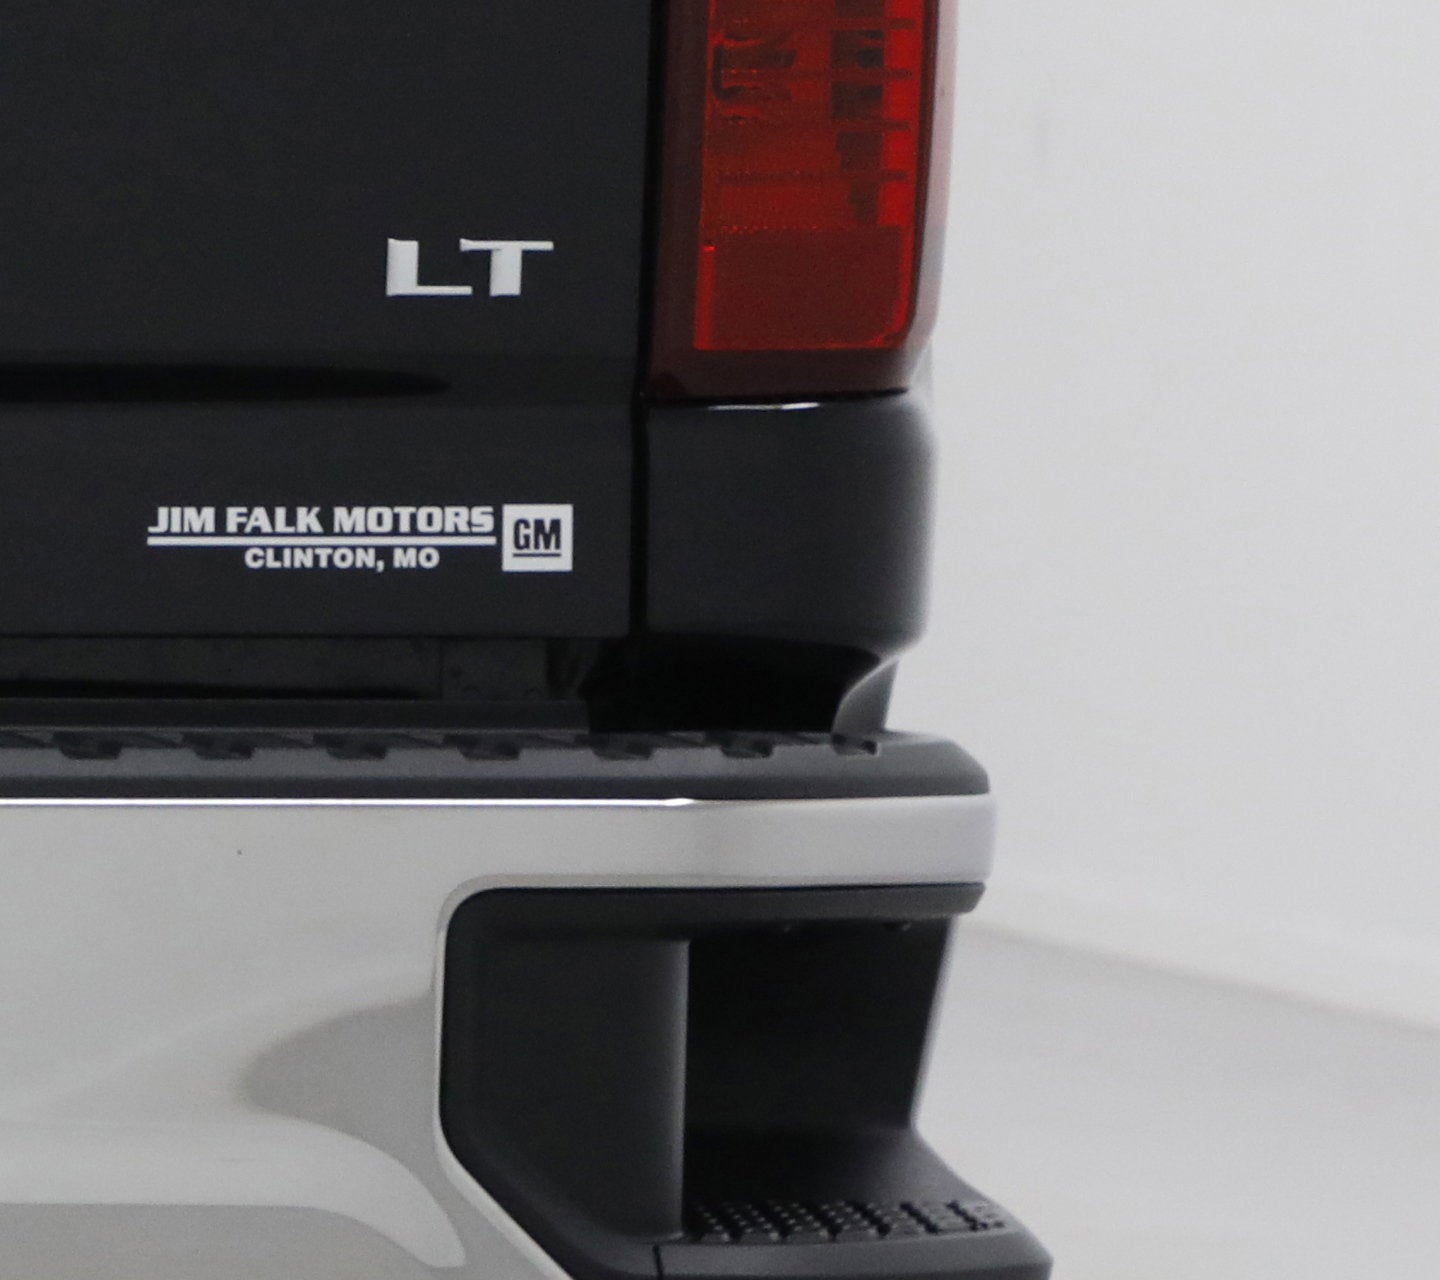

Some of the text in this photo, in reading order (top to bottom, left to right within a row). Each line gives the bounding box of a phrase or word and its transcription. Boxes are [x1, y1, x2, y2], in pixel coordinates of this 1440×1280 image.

[385, 237, 555, 298] LT
[147, 505, 495, 535] JIM FALK MOTORS
[512, 518, 562, 551] GM
[243, 547, 441, 573] CLINTON, MO
